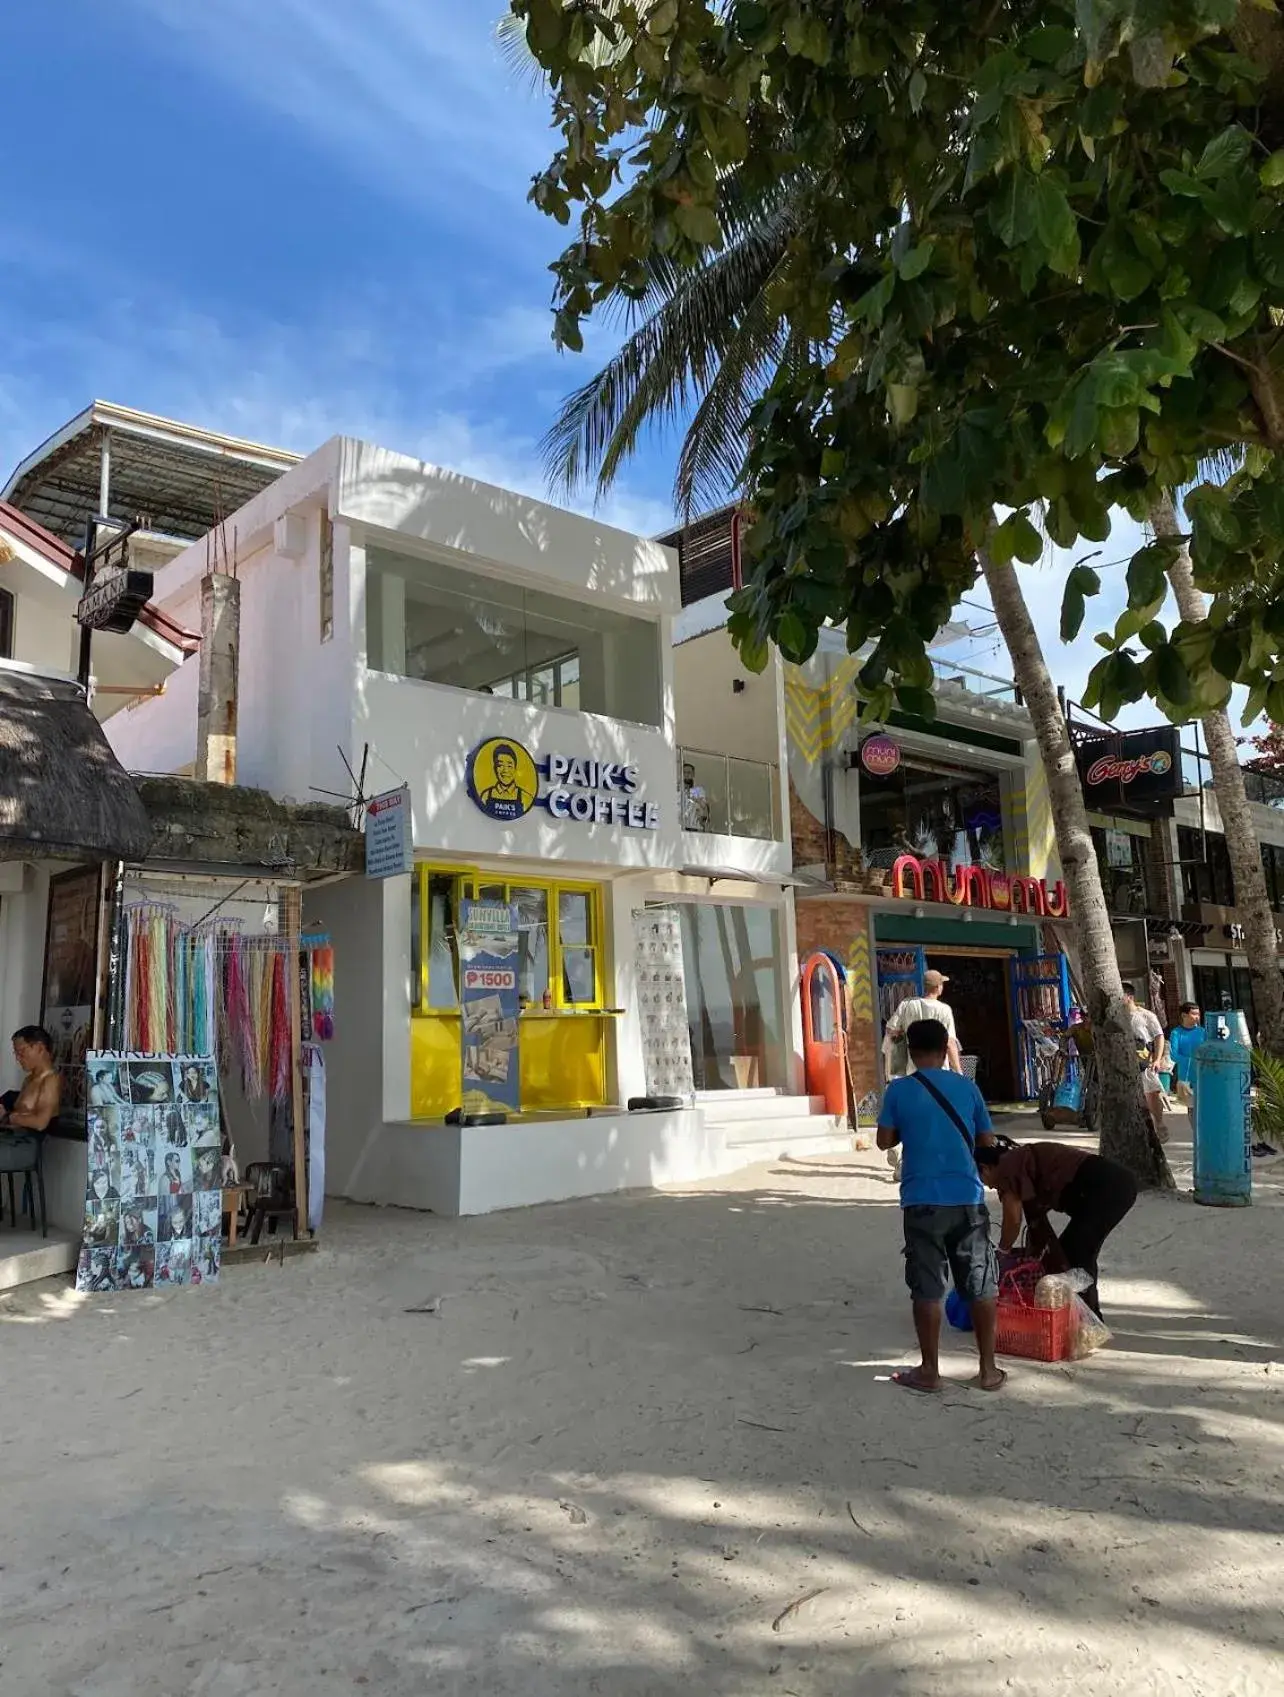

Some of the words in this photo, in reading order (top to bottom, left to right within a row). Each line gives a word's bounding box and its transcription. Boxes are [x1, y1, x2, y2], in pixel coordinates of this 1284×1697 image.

[548, 752, 640, 793] PAIK'S
[548, 788, 661, 830] COFFEE
[894, 854, 991, 908] muni
